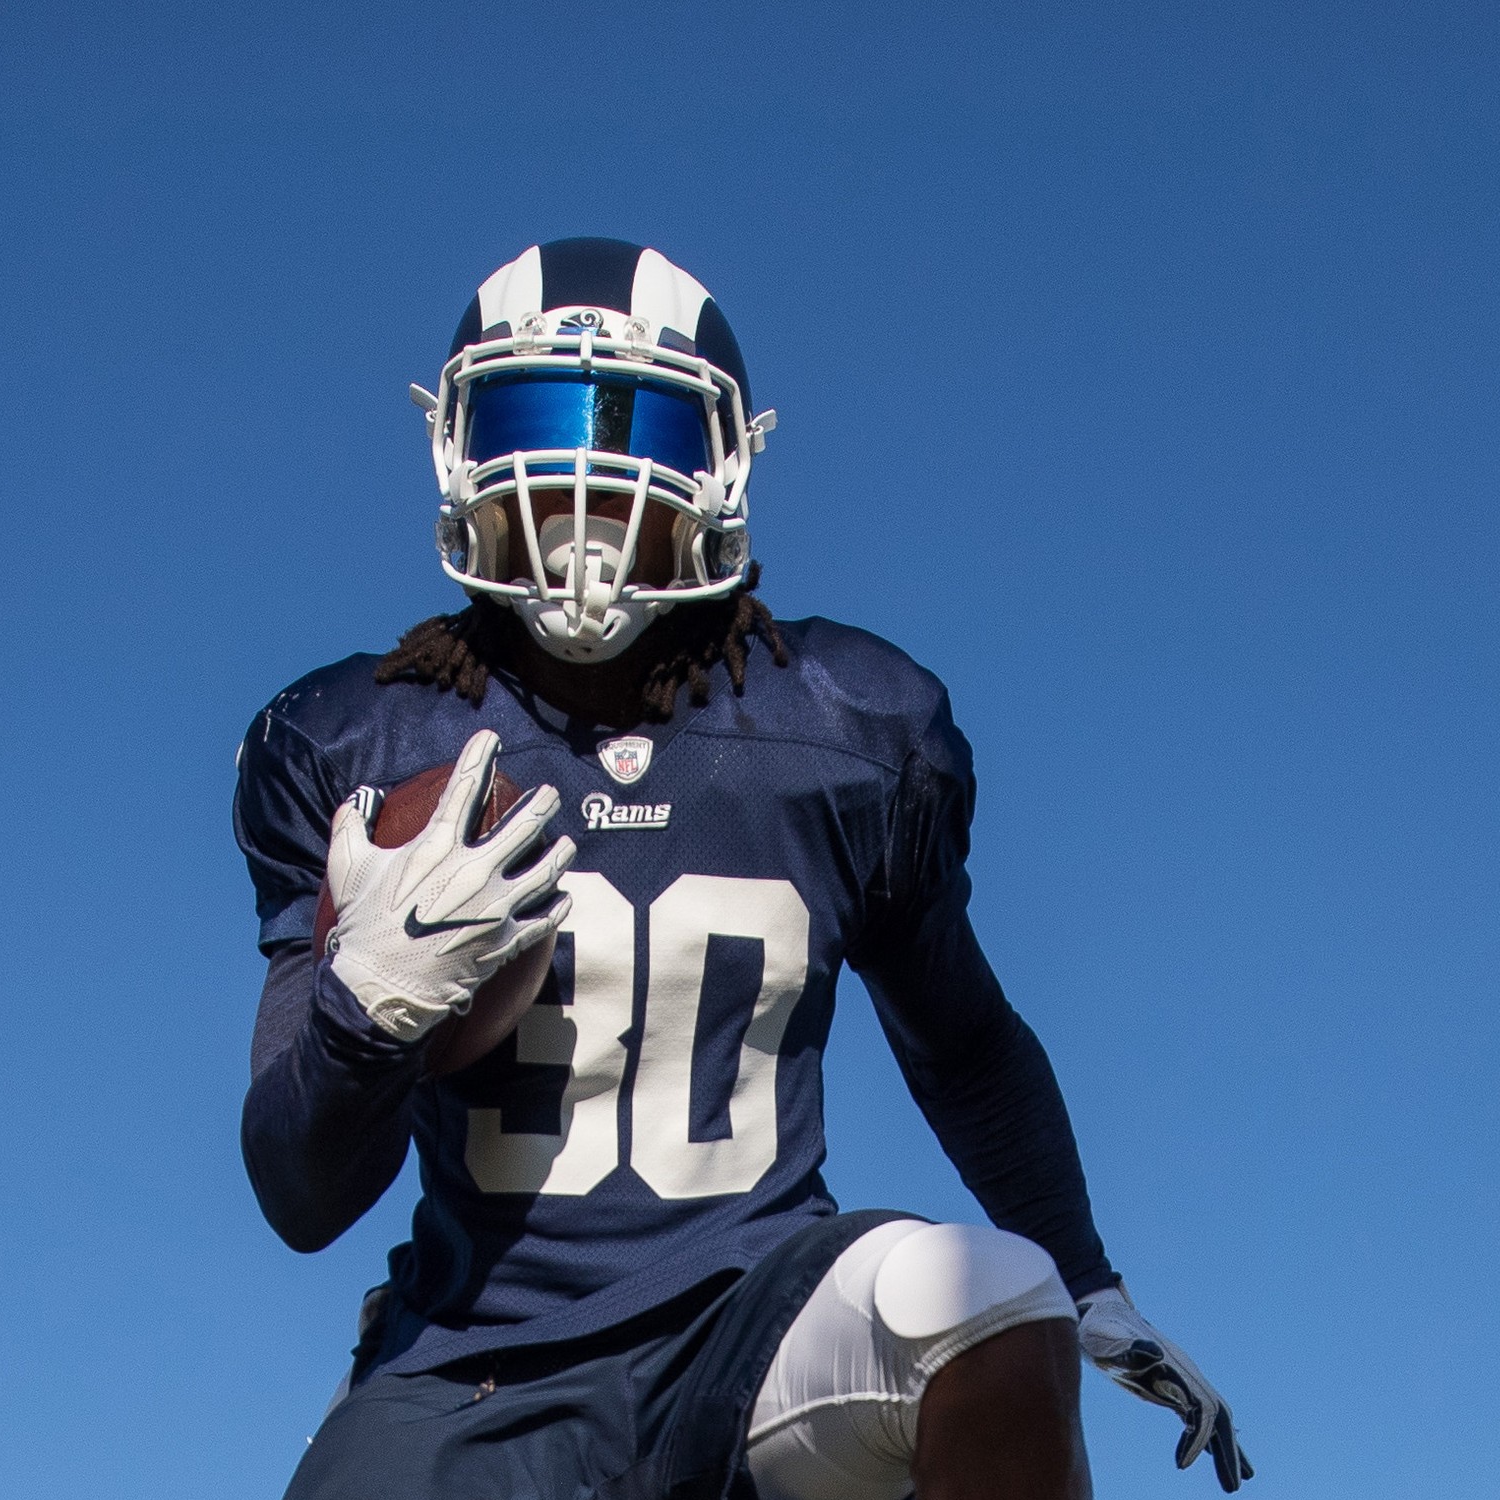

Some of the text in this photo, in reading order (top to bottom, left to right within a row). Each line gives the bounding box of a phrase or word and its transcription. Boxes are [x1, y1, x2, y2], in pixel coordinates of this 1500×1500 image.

[617, 759, 638, 772] NFL
[581, 792, 672, 829] Rams
[464, 871, 810, 1200] 30
